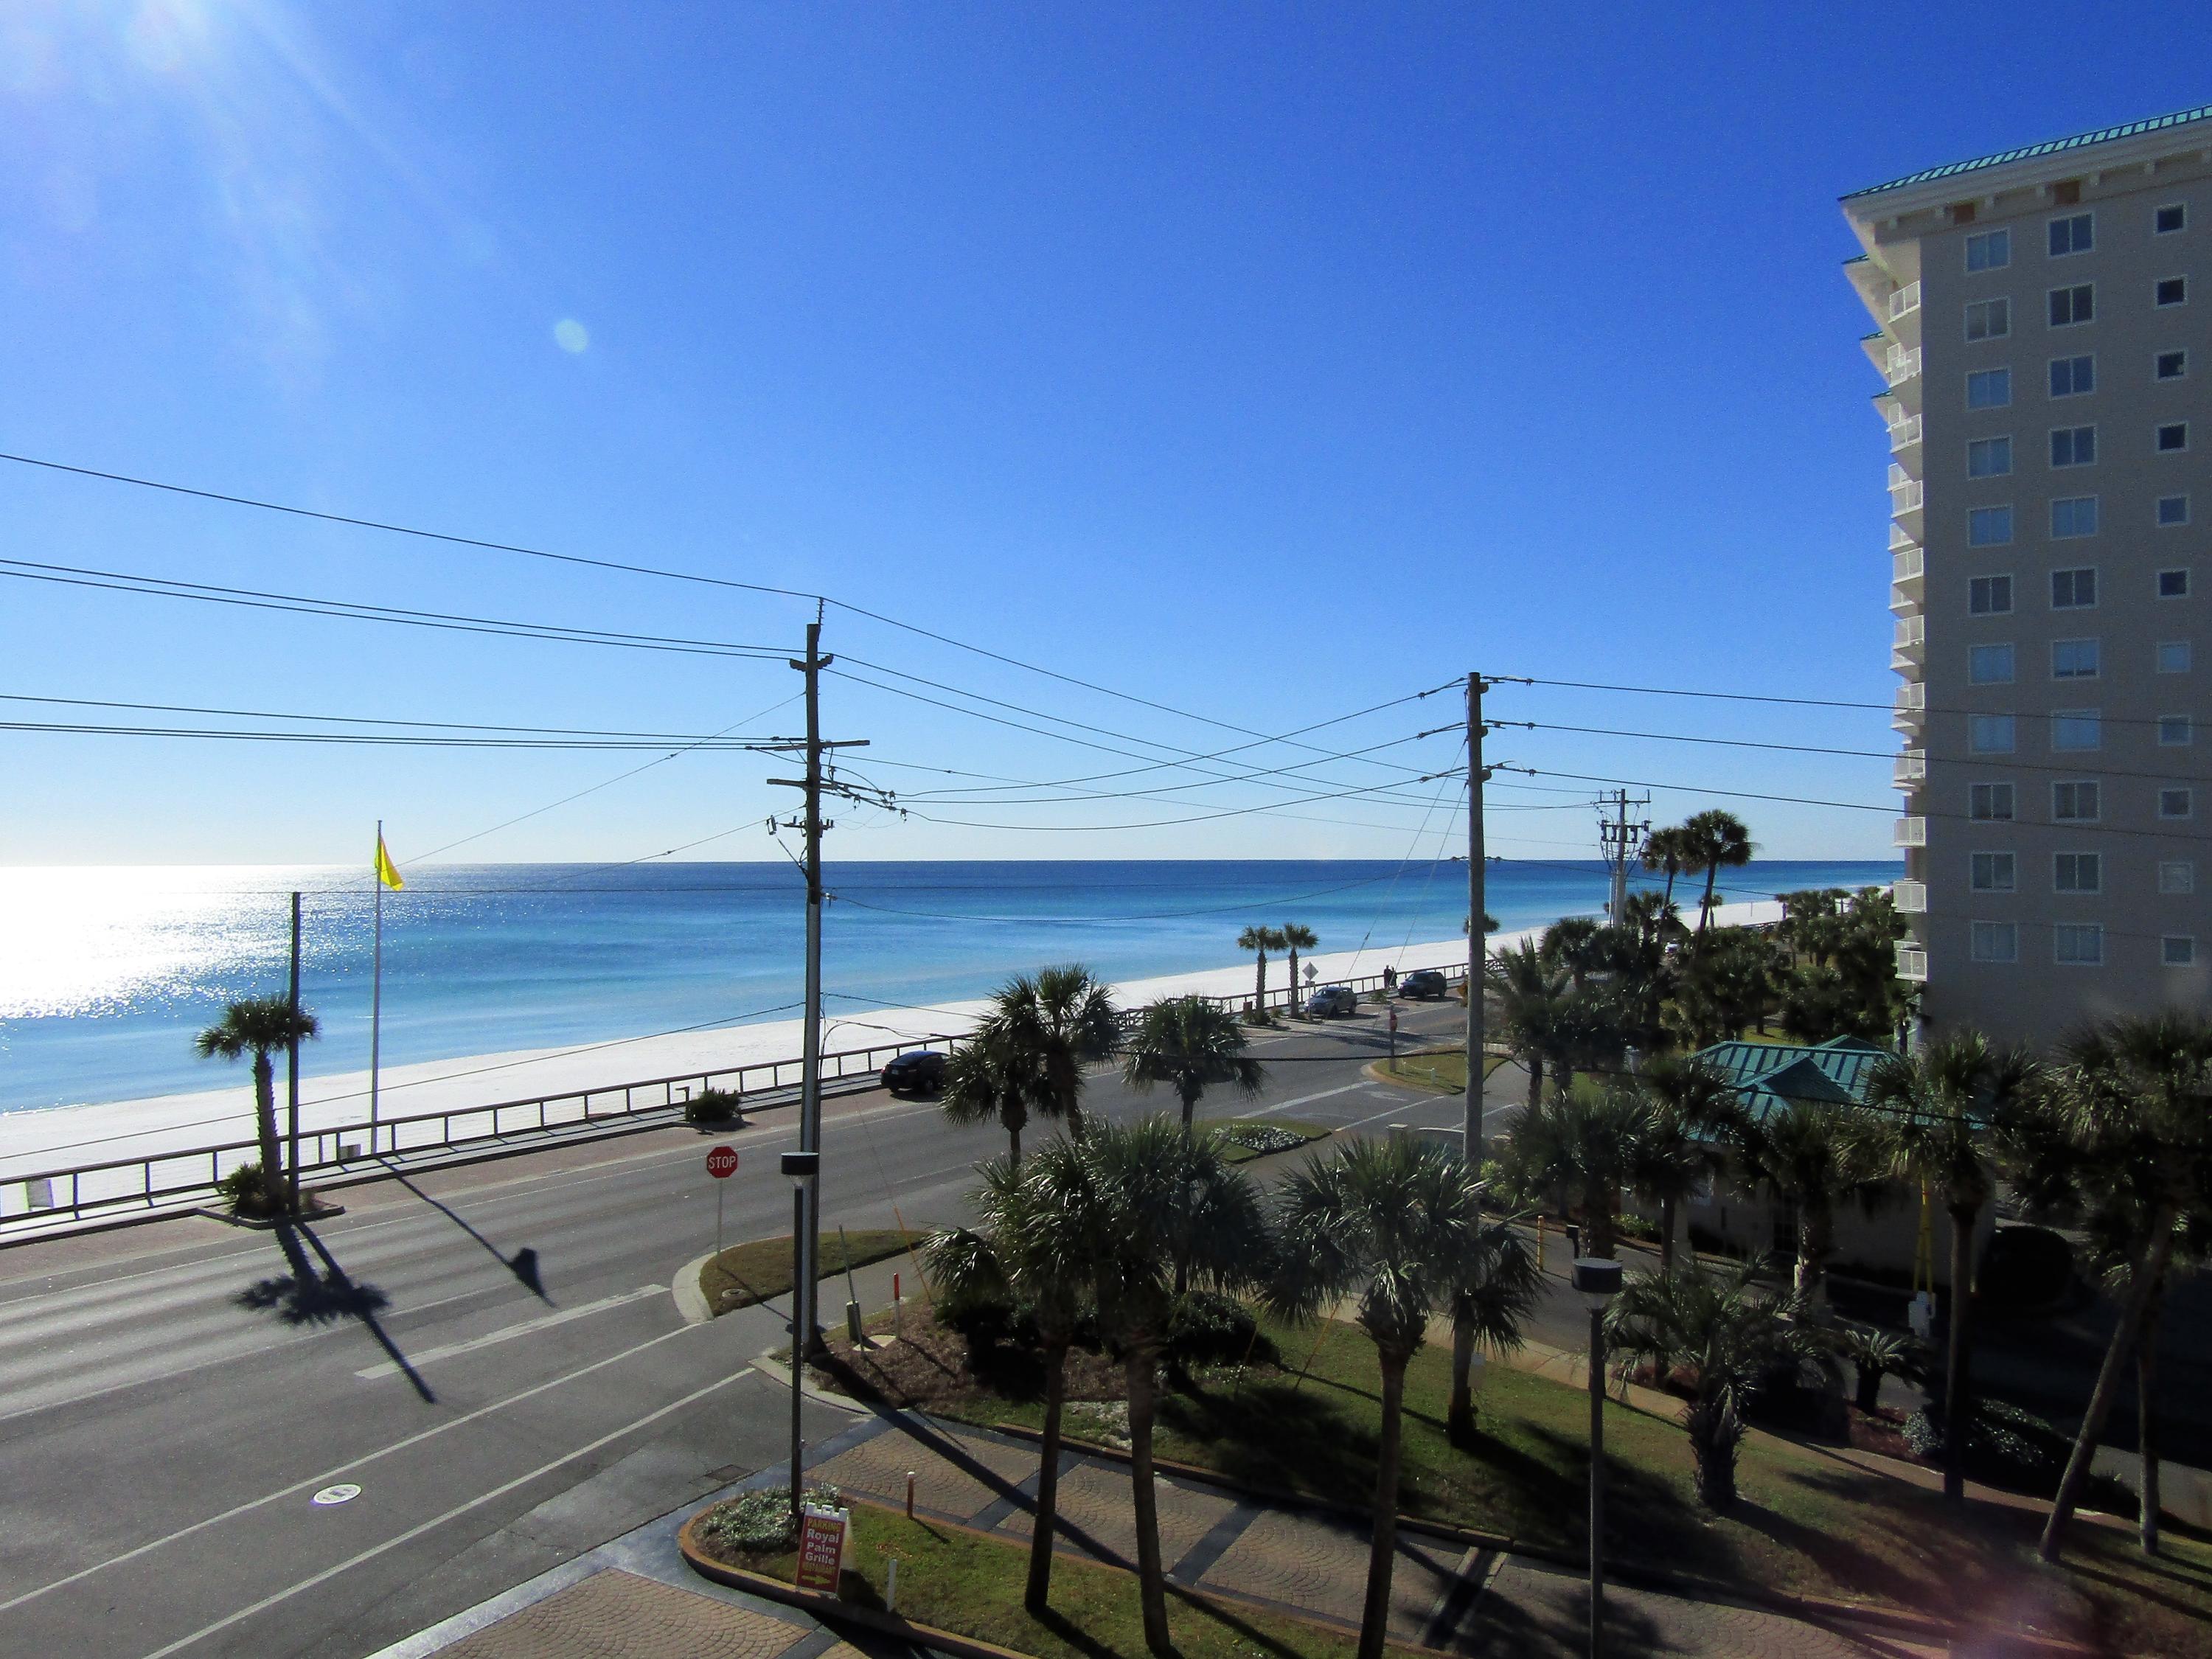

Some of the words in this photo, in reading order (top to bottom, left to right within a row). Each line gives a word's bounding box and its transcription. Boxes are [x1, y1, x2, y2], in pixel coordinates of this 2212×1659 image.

[708, 1155, 736, 1169] STOP
[807, 1528, 839, 1543] Royal
[807, 1542, 835, 1554] Palm
[805, 1552, 835, 1565] Grille
